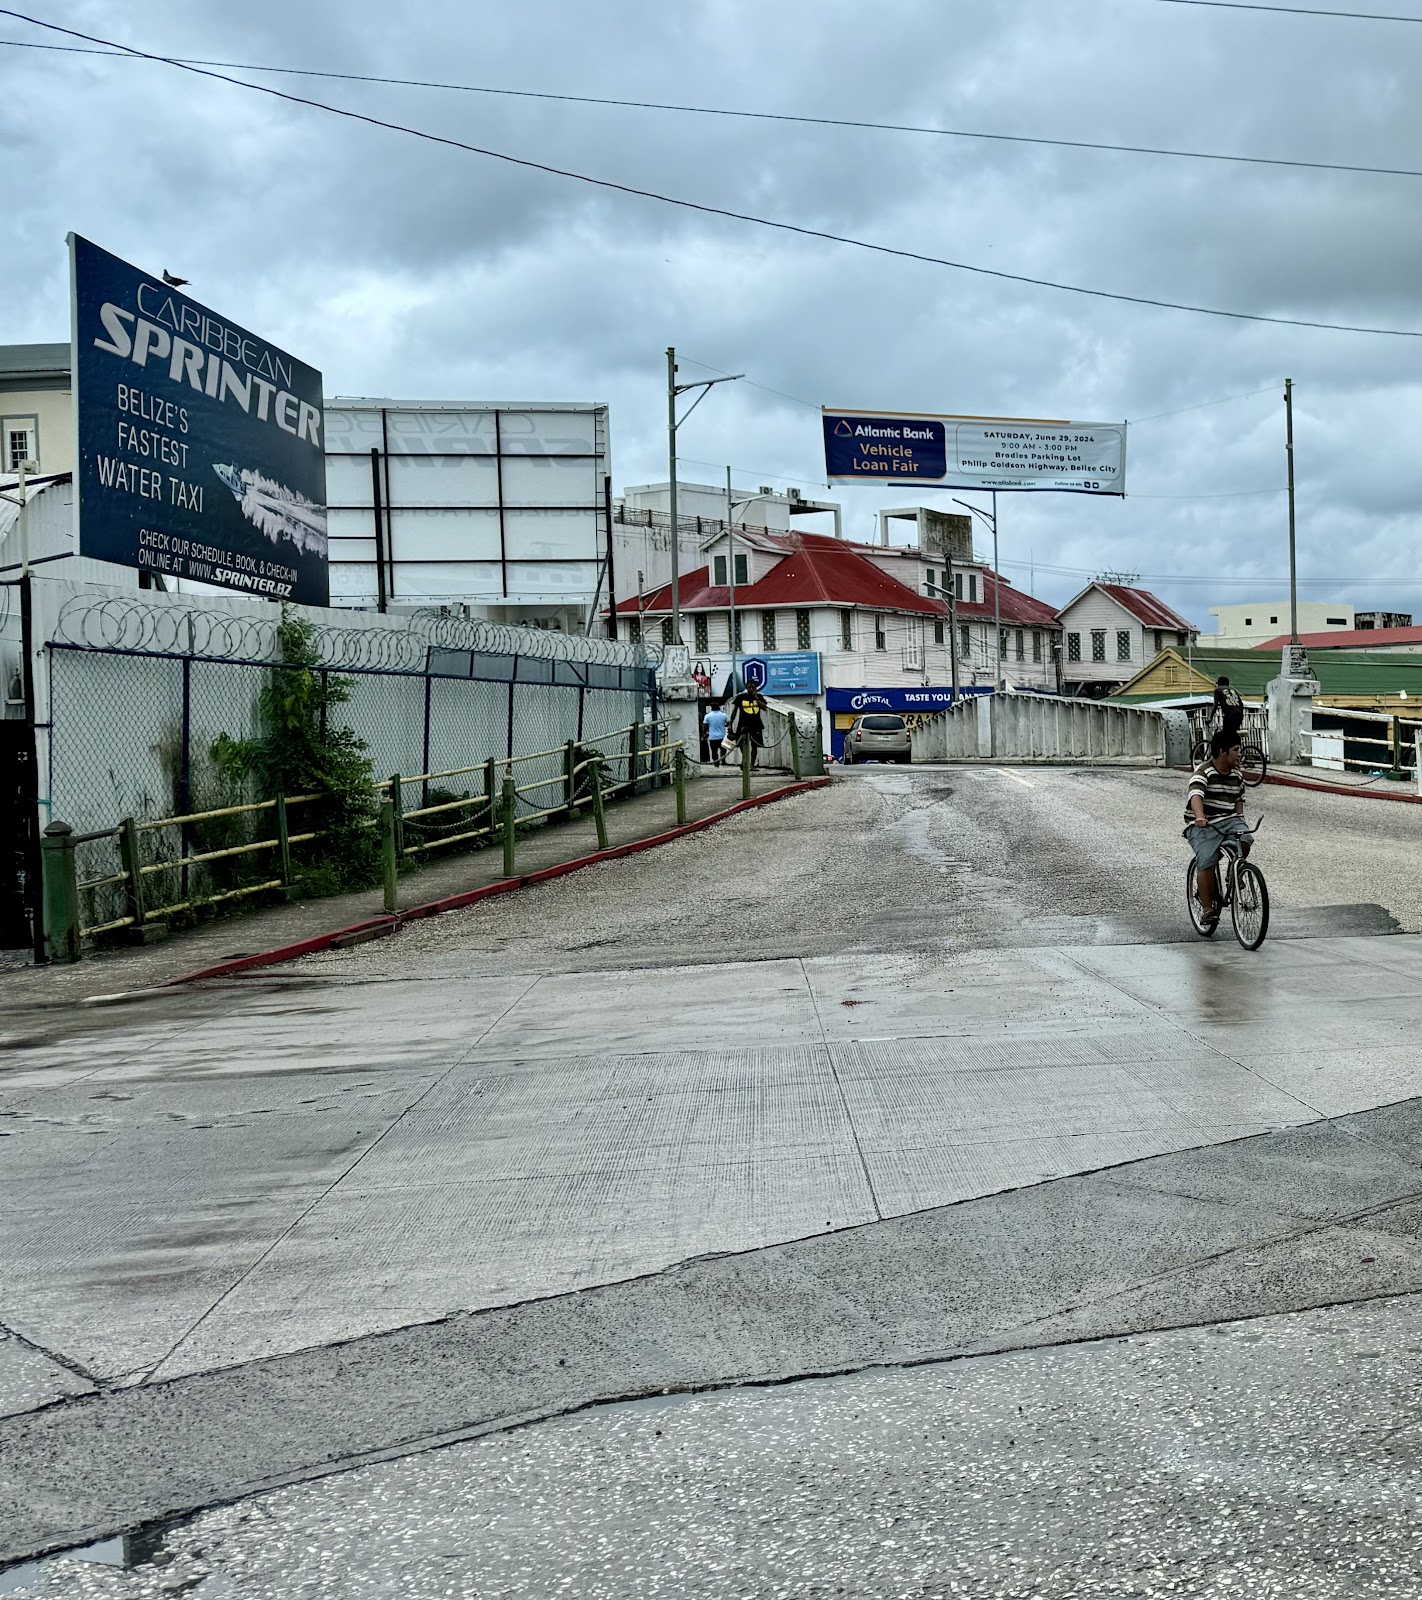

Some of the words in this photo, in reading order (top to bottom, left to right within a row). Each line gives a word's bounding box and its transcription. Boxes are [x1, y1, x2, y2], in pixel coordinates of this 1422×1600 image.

[138, 282, 292, 388] CARIBBEAN
[94, 302, 321, 448] SPRINTER
[118, 384, 188, 434] BELIZE'S
[855, 425, 901, 438] Atlantic
[903, 427, 934, 440] Bank
[984, 432, 1033, 441] SATURDAY,
[1059, 435, 1072, 443] 29,
[118, 422, 189, 469] FASTEST
[860, 443, 913, 457] Vehicle
[854, 458, 888, 471] Loan
[893, 460, 919, 472] Fair
[962, 460, 988, 468] Philip
[991, 461, 1026, 469] Goldson
[1029, 463, 1068, 472] Highway,
[1071, 464, 1096, 472] Belize
[1100, 466, 1116, 474] City
[1032, 453, 1065, 462] Parking
[97, 455, 162, 501] WATER
[169, 477, 203, 513] TAXI
[138, 548, 170, 570] ONLINE
[172, 557, 184, 573] AT
[140, 529, 170, 550] CHECK
[172, 538, 189, 553] OUR
[191, 543, 233, 568] SCHEDULE,
[236, 554, 258, 574] BOOK,
[260, 561, 265, 574] &
[266, 564, 298, 582] CHECK-IN
[905, 694, 930, 702] TASTE
[932, 694, 951, 702] YOU
